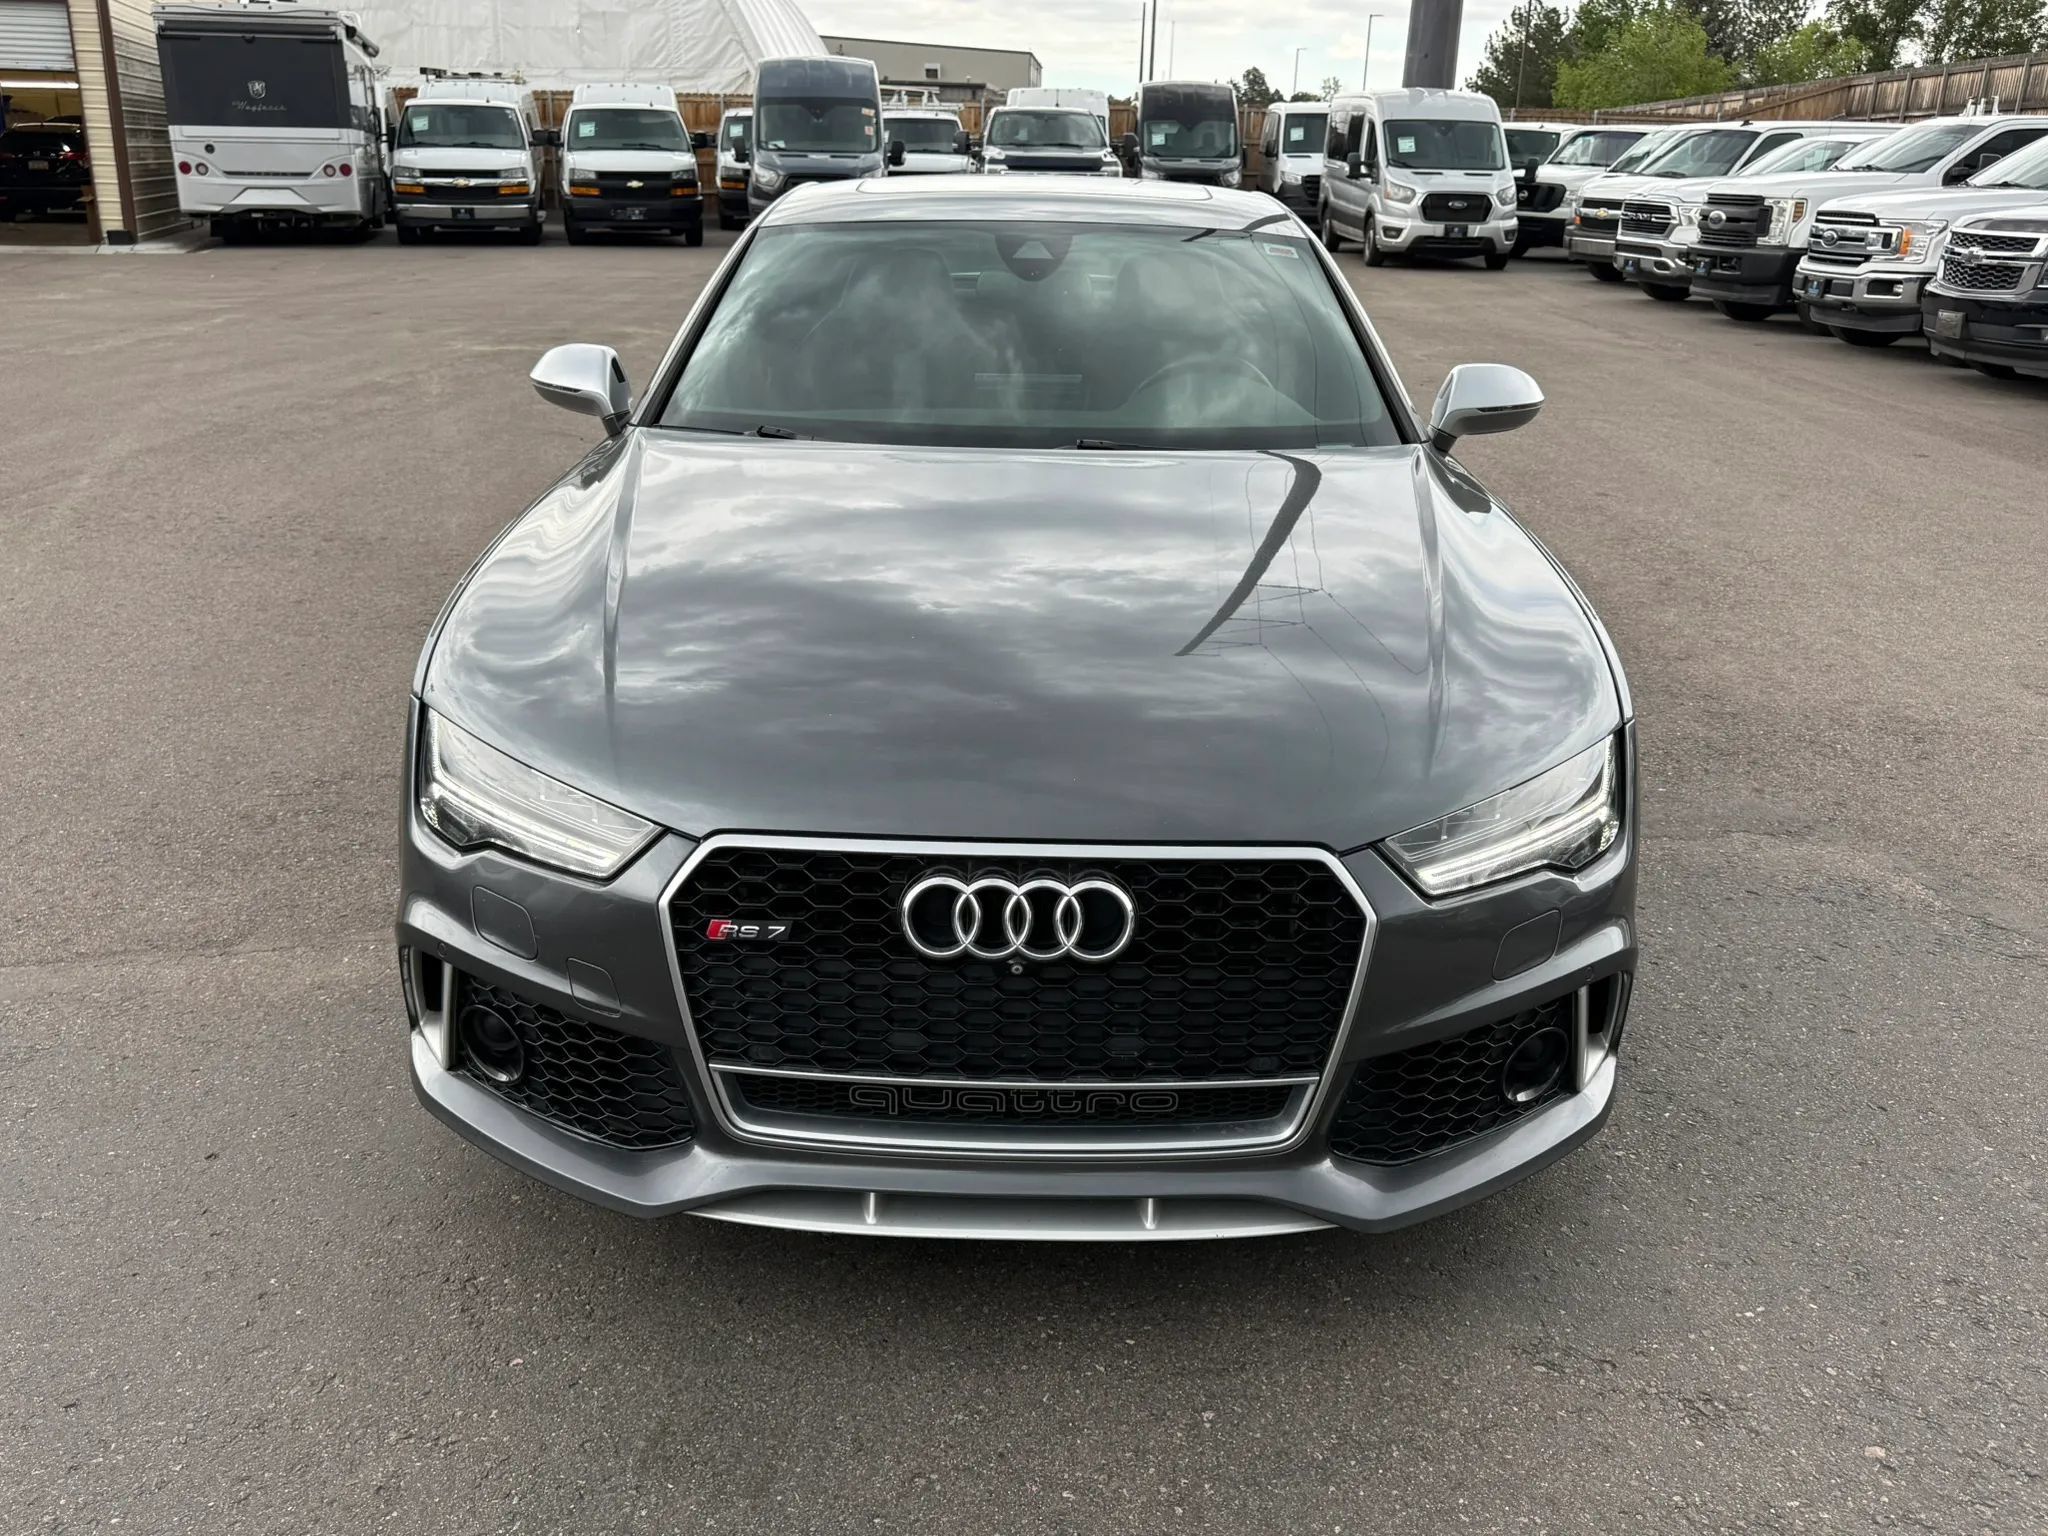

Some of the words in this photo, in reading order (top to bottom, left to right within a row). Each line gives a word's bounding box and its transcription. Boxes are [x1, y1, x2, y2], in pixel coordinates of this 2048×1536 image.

[717, 924, 760, 938] RS
[768, 926, 786, 939] 7
[849, 1086, 1179, 1114] quattro
